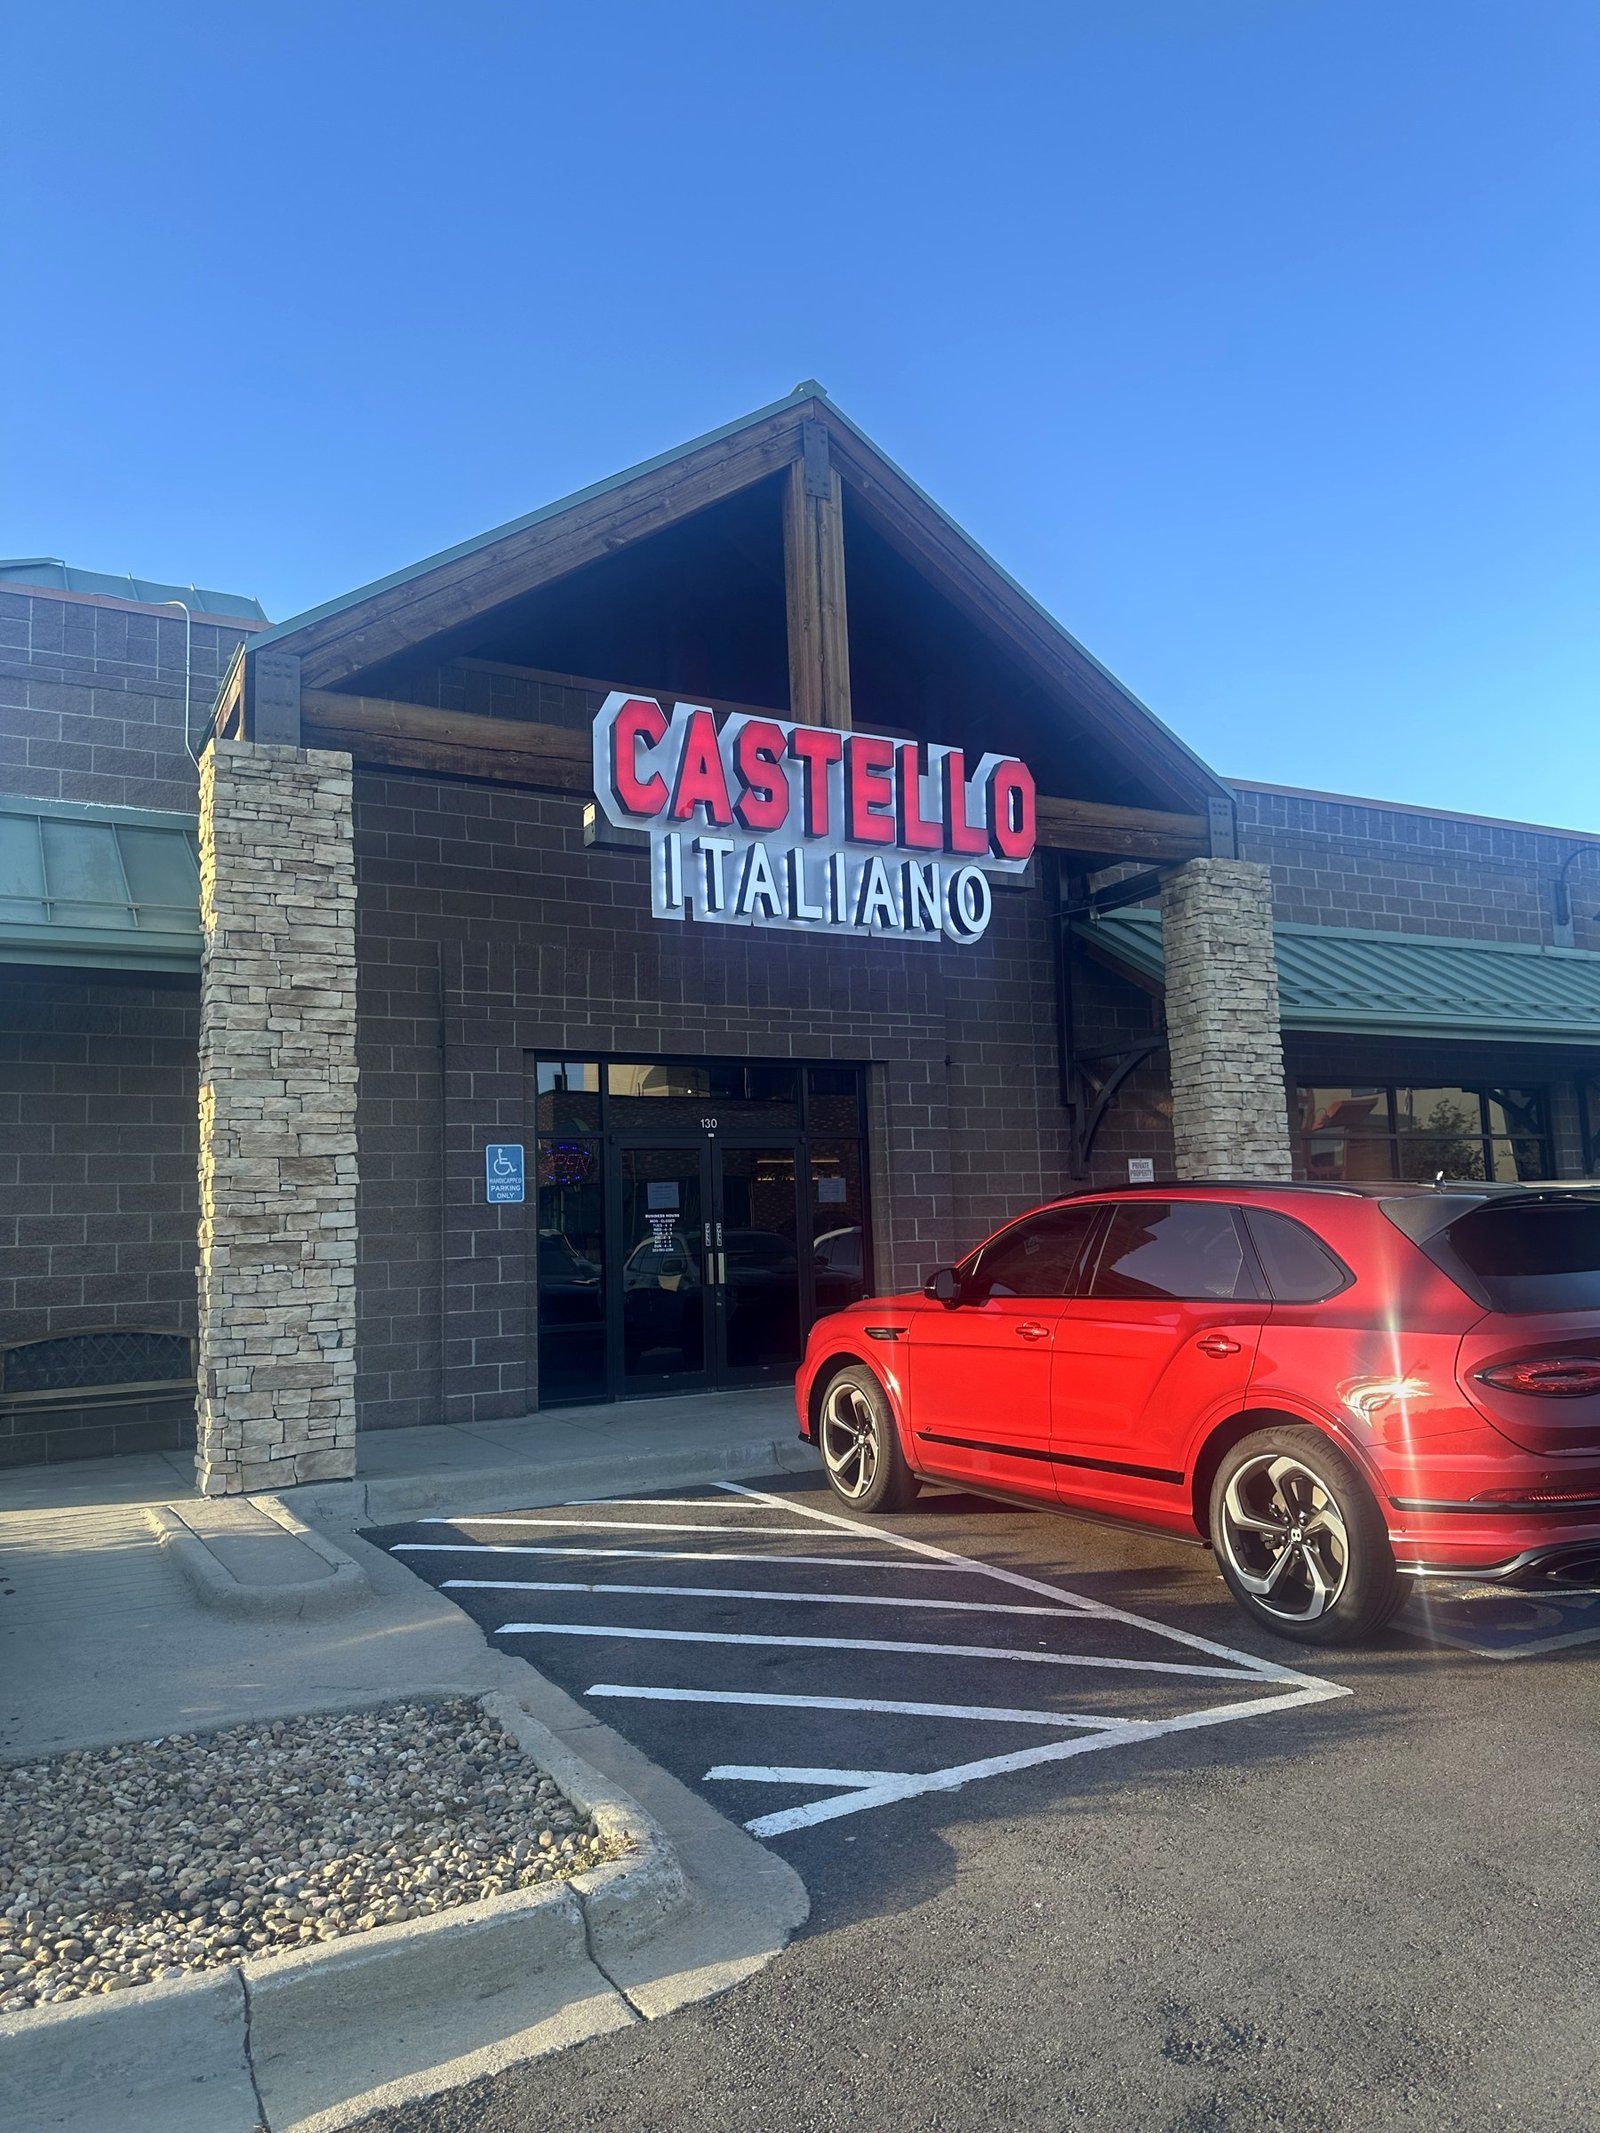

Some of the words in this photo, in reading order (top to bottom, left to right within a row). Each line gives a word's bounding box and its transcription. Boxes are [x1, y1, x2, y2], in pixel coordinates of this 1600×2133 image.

[611, 699, 1036, 860] CASTELLO
[665, 832, 992, 934] ITALIANO
[700, 1118, 718, 1129] 130
